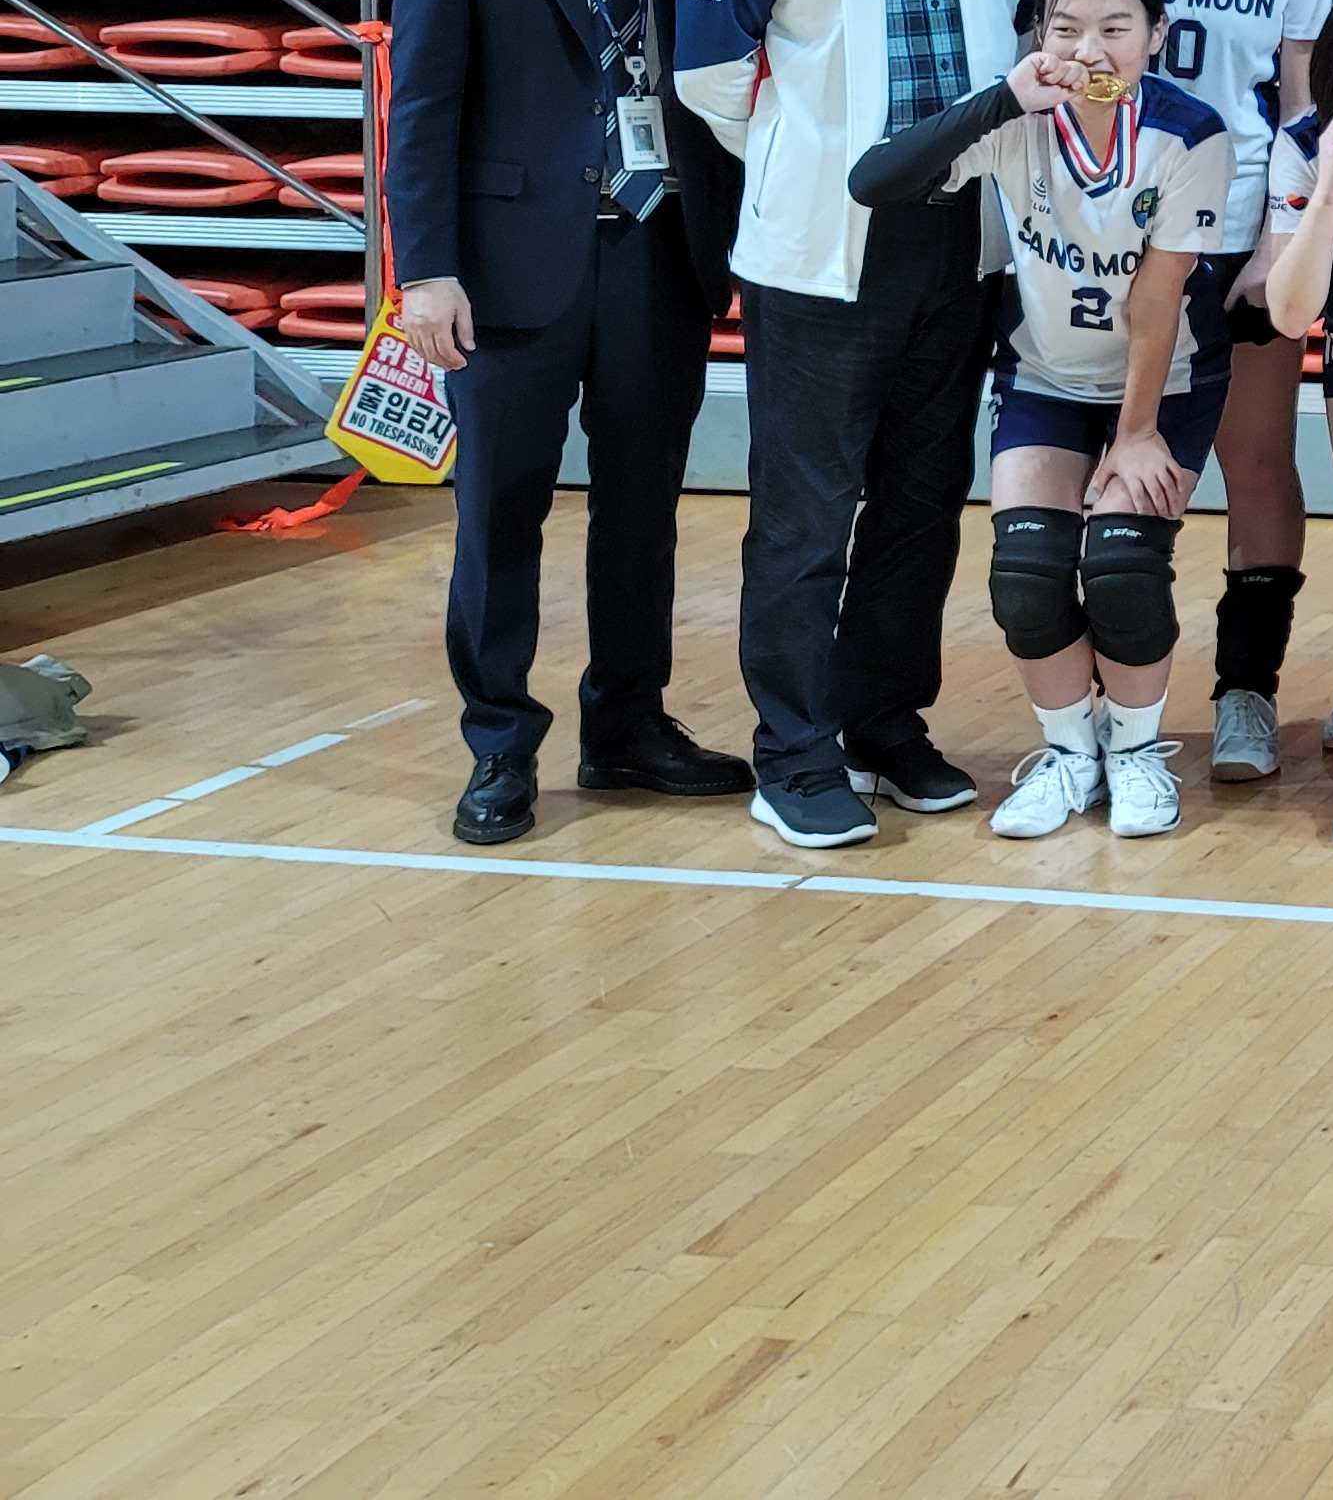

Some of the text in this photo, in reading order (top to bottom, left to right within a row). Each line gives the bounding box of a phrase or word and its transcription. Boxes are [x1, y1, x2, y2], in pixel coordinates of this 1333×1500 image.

[1018, 216, 1085, 273] SANG
[1070, 286, 1114, 331] 2
[366, 359, 430, 396] DANGER!
[348, 410, 440, 460] NO TRESPASSING
[356, 382, 450, 445] 출입금지
